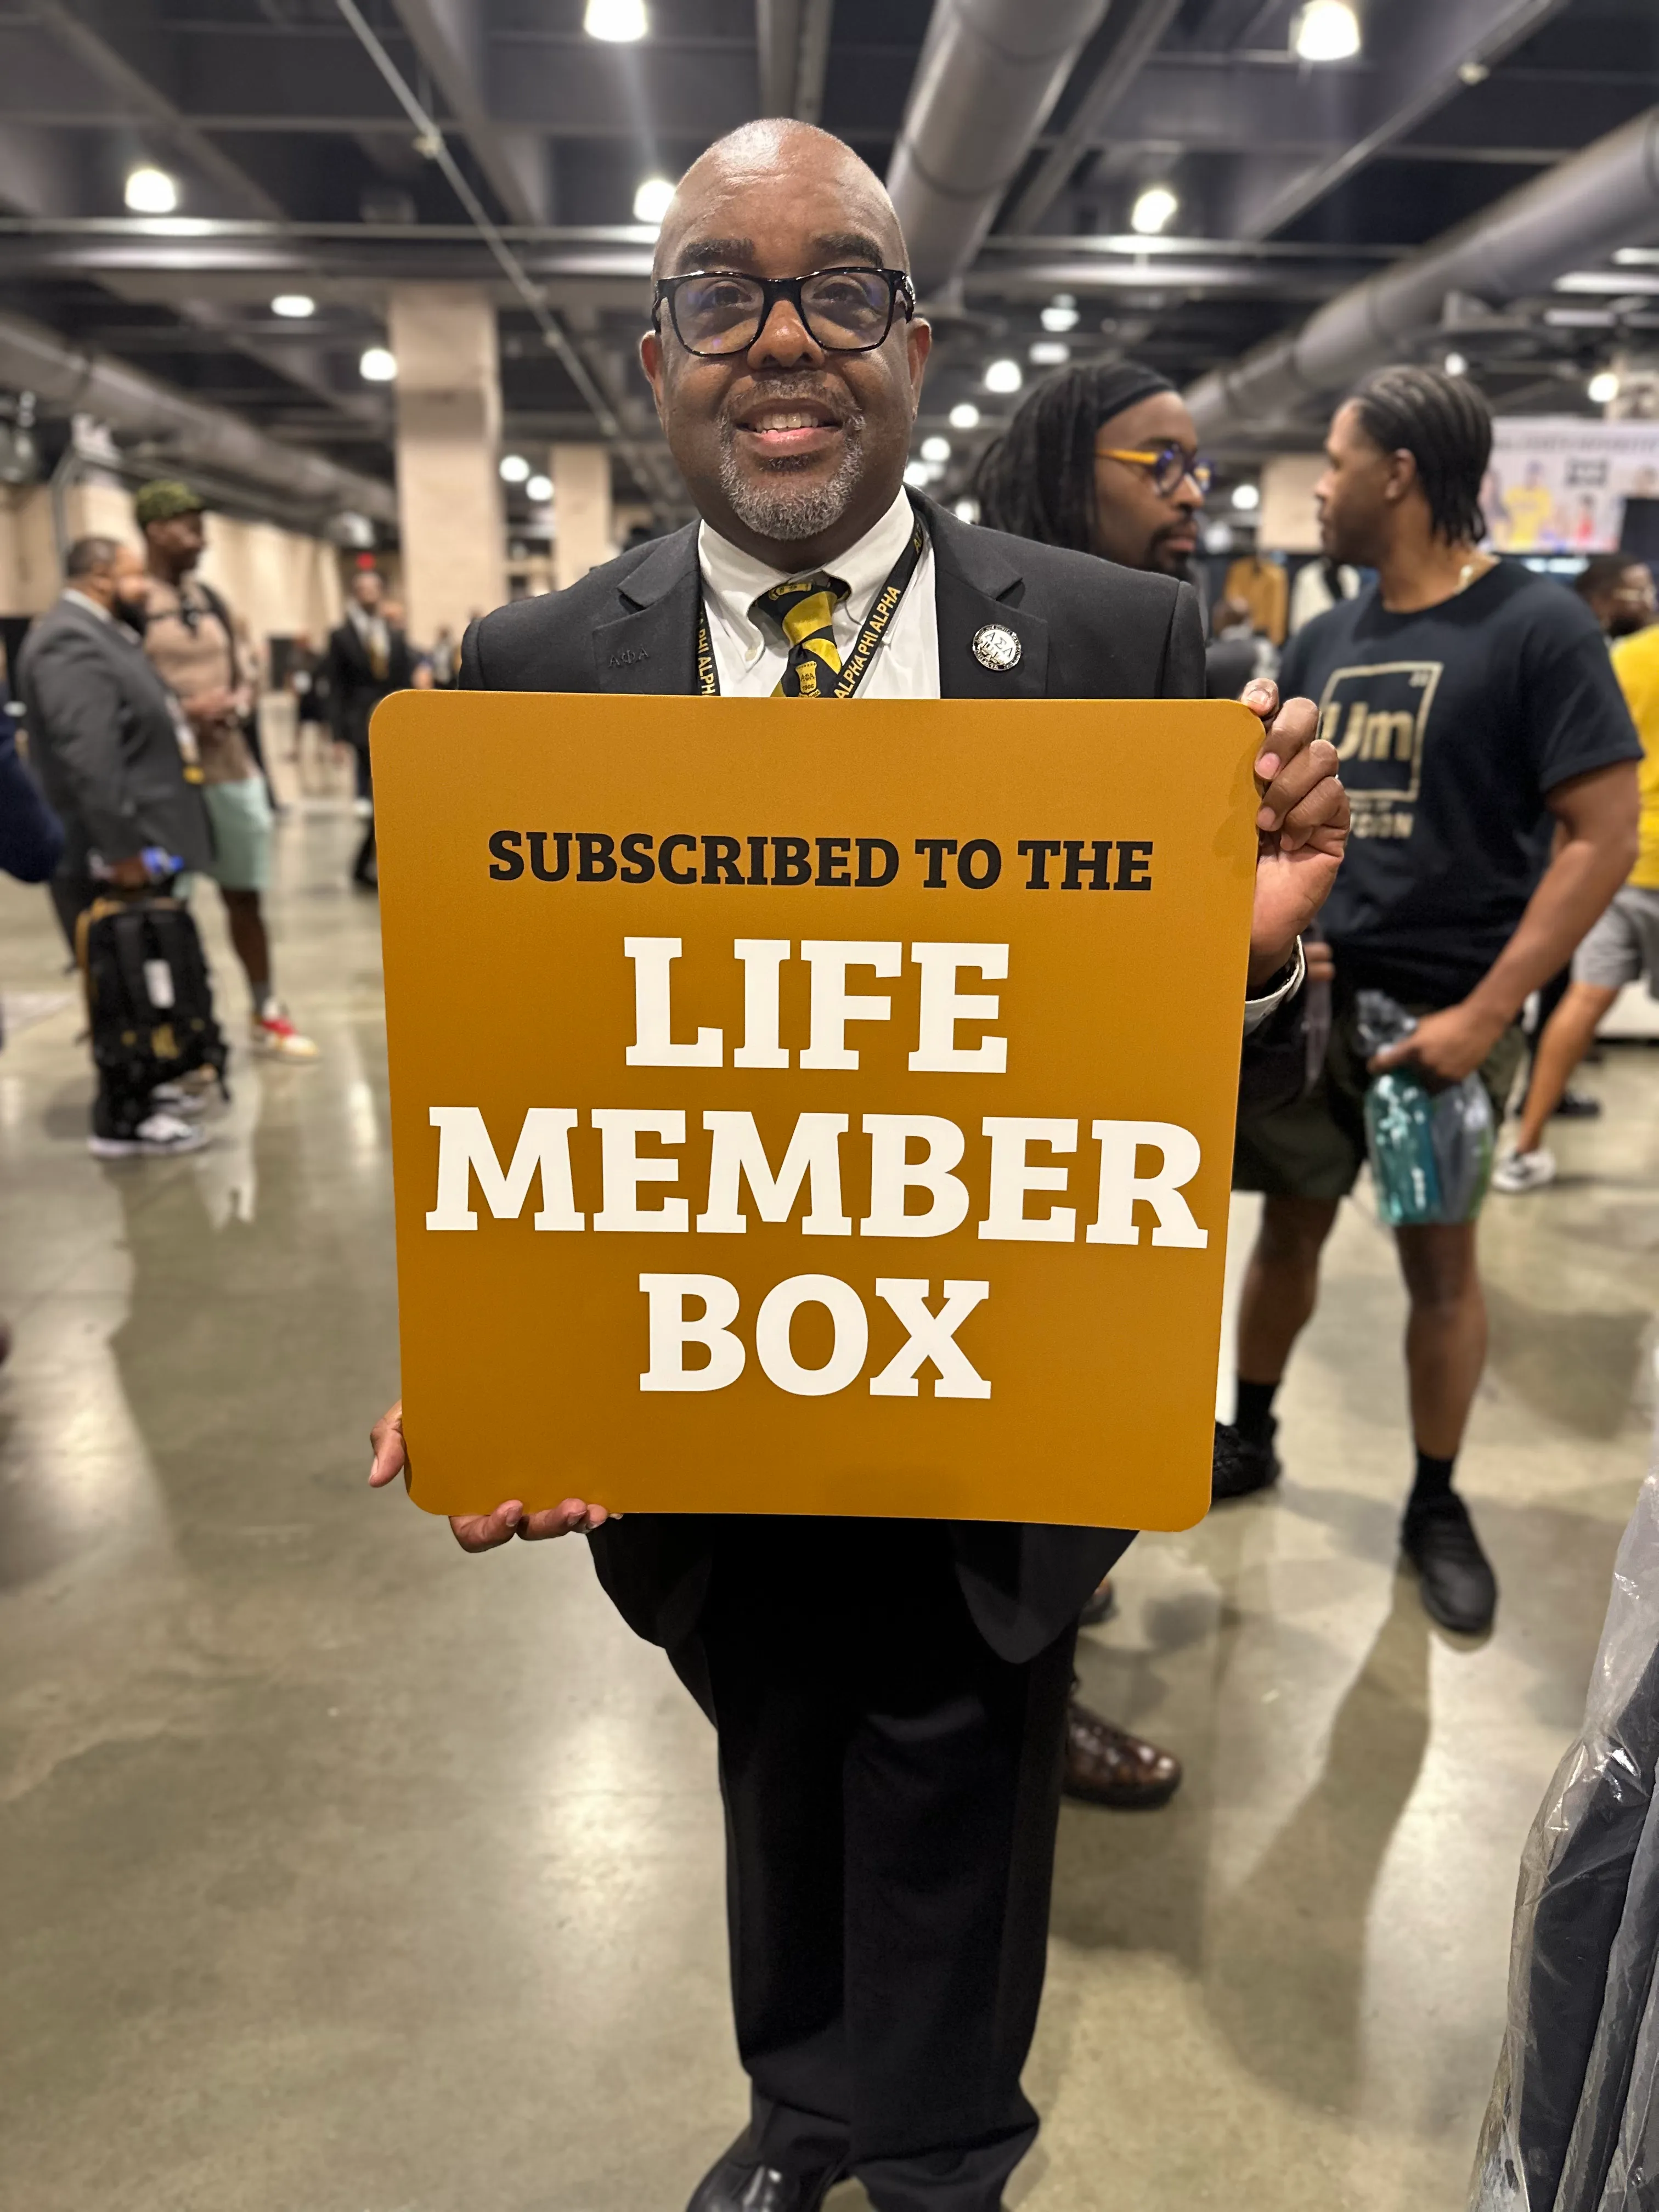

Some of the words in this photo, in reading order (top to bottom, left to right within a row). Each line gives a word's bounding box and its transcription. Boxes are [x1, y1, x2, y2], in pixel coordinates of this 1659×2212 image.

[698, 657, 715, 696] ALPH
[834, 654, 867, 698] ALPHA
[857, 630, 878, 656] PHI
[869, 586, 901, 633] ALPHA
[489, 830, 899, 887] SUBSCRIBED
[915, 839, 1002, 890] TO
[1017, 840, 1153, 891] THE
[624, 936, 1009, 1073] LIFE
[426, 1107, 1208, 1249] MEMBER
[639, 1273, 991, 1399] BOX
